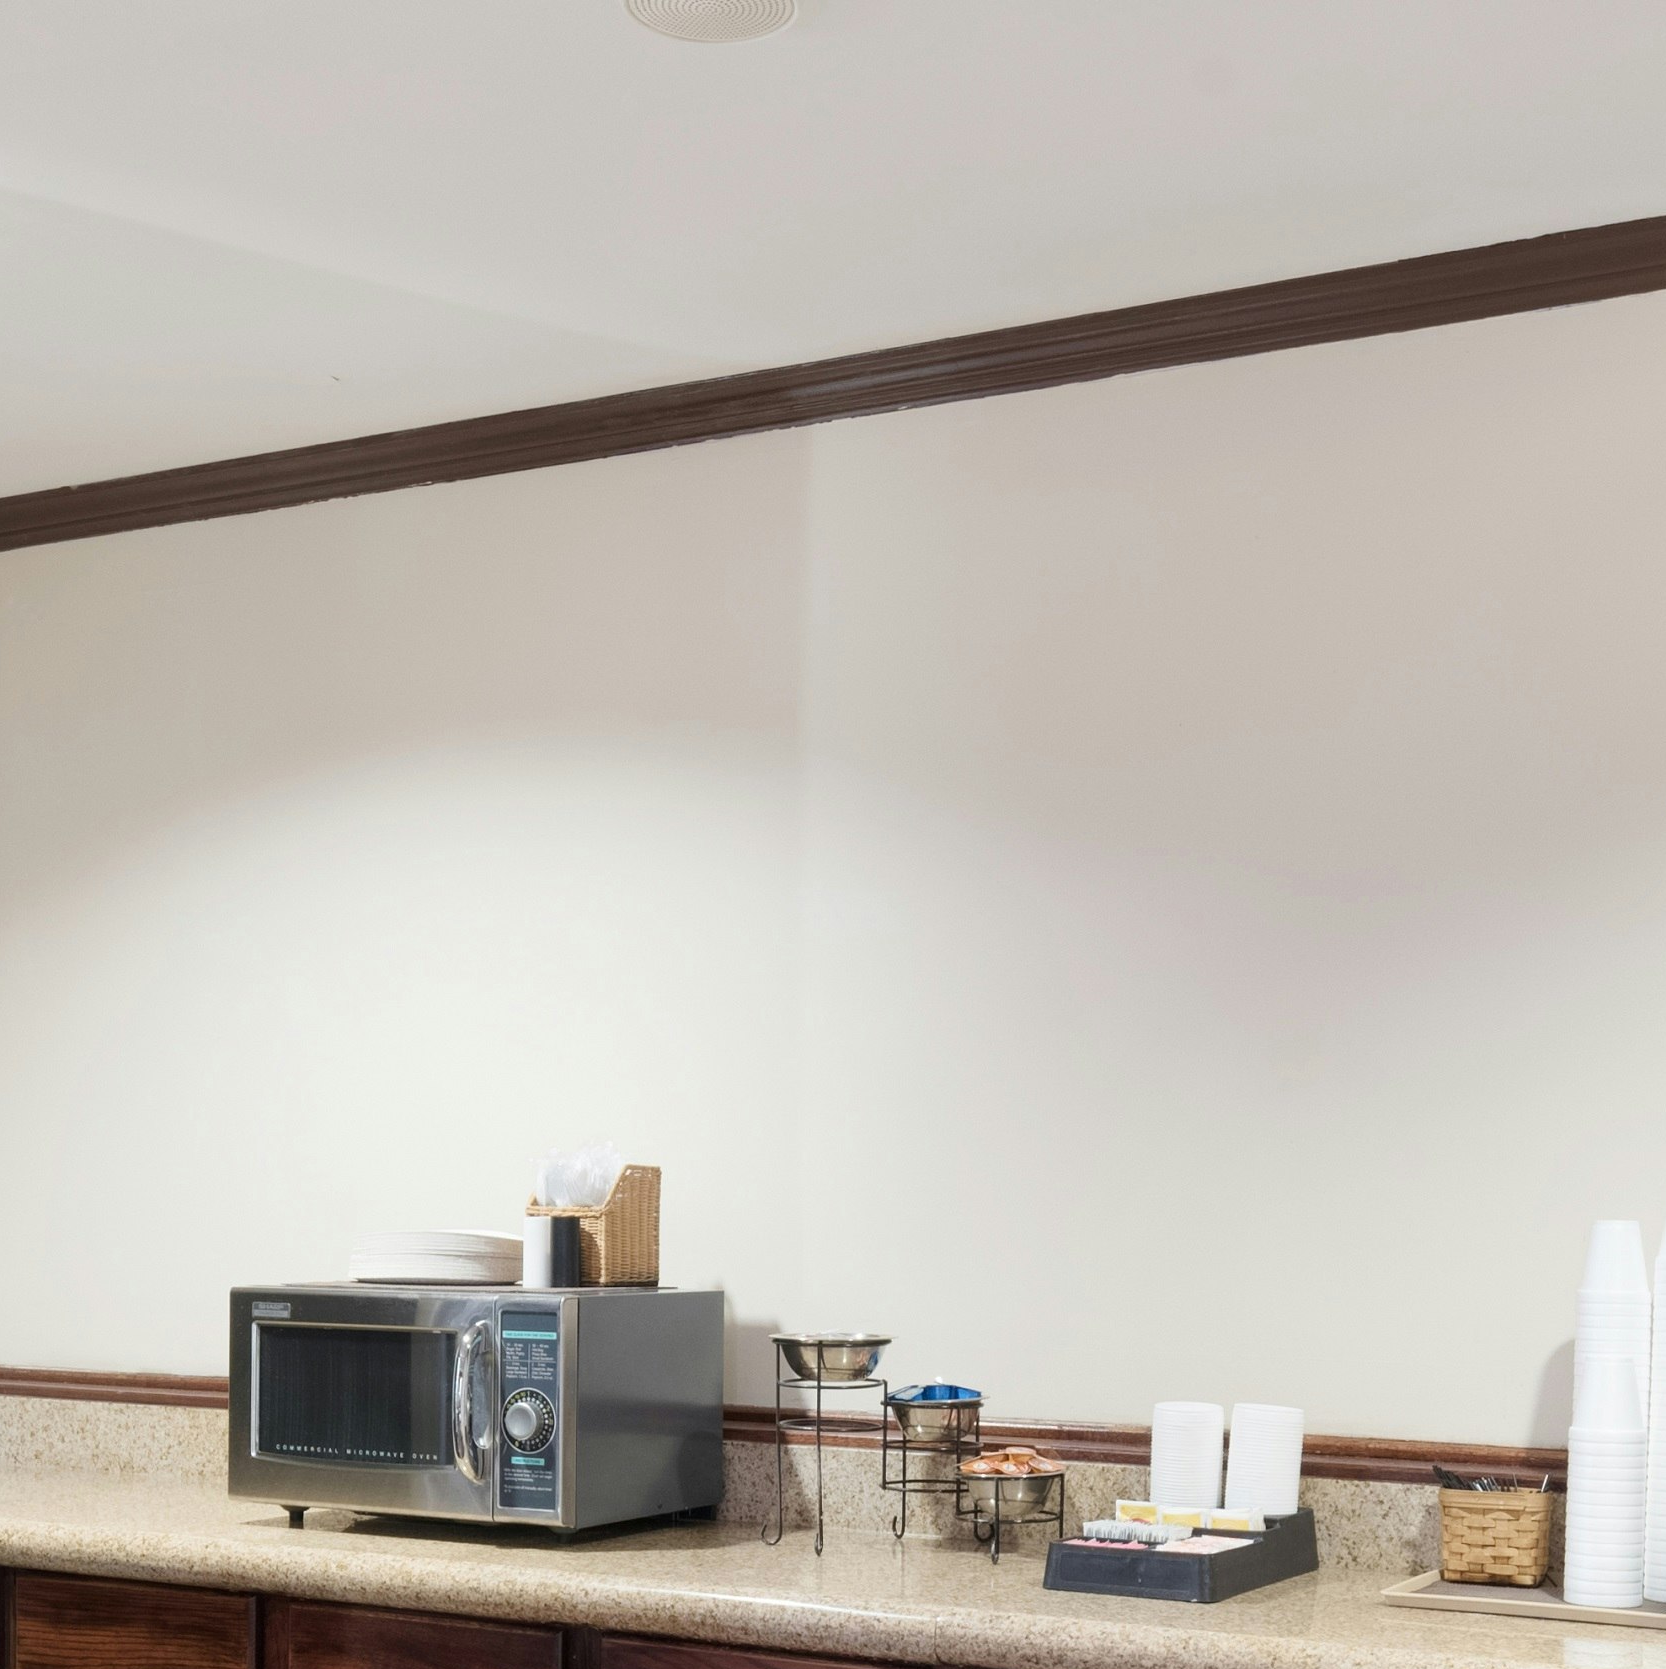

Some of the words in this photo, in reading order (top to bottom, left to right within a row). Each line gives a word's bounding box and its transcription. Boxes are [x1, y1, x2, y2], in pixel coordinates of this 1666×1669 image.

[276, 1444, 339, 1455] COMMERCIAL
[346, 1449, 405, 1459] MICROWAVE
[412, 1453, 438, 1461] OVEN
